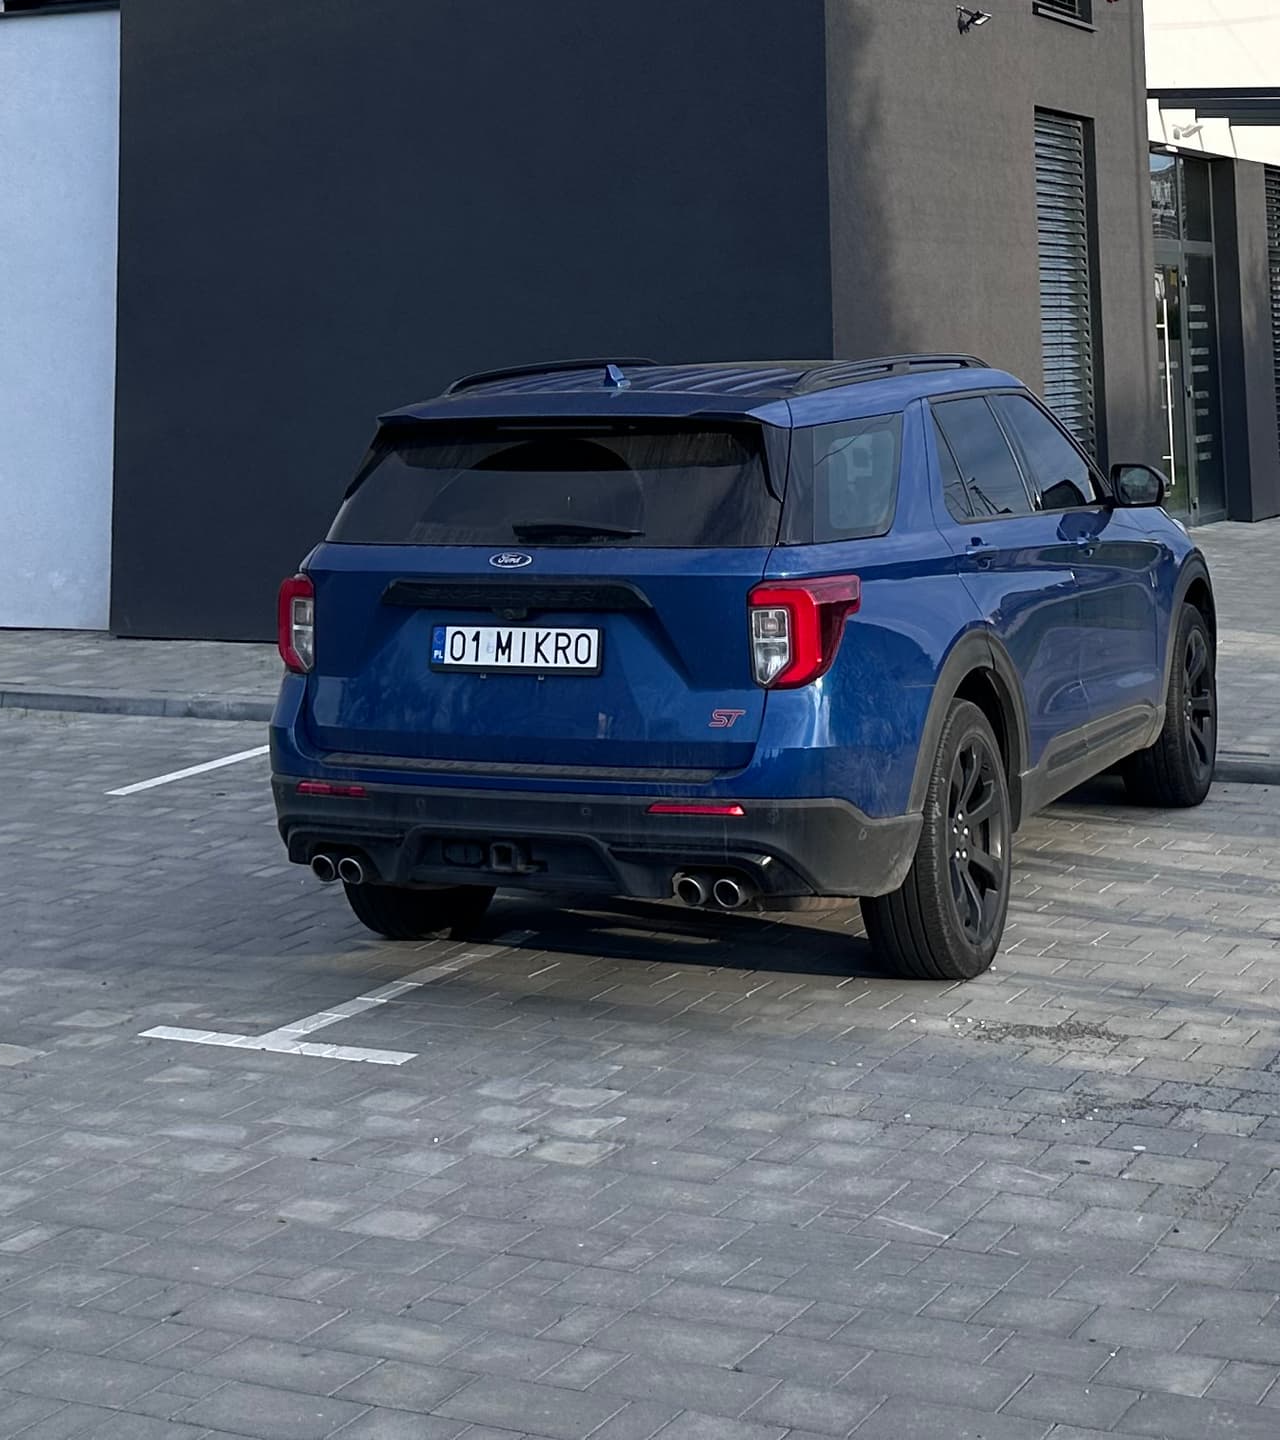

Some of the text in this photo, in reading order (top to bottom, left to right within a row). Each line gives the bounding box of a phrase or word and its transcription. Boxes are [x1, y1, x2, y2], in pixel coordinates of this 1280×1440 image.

[433, 650, 443, 659] PL
[495, 631, 591, 664] MIKRO
[708, 709, 746, 727] ST
